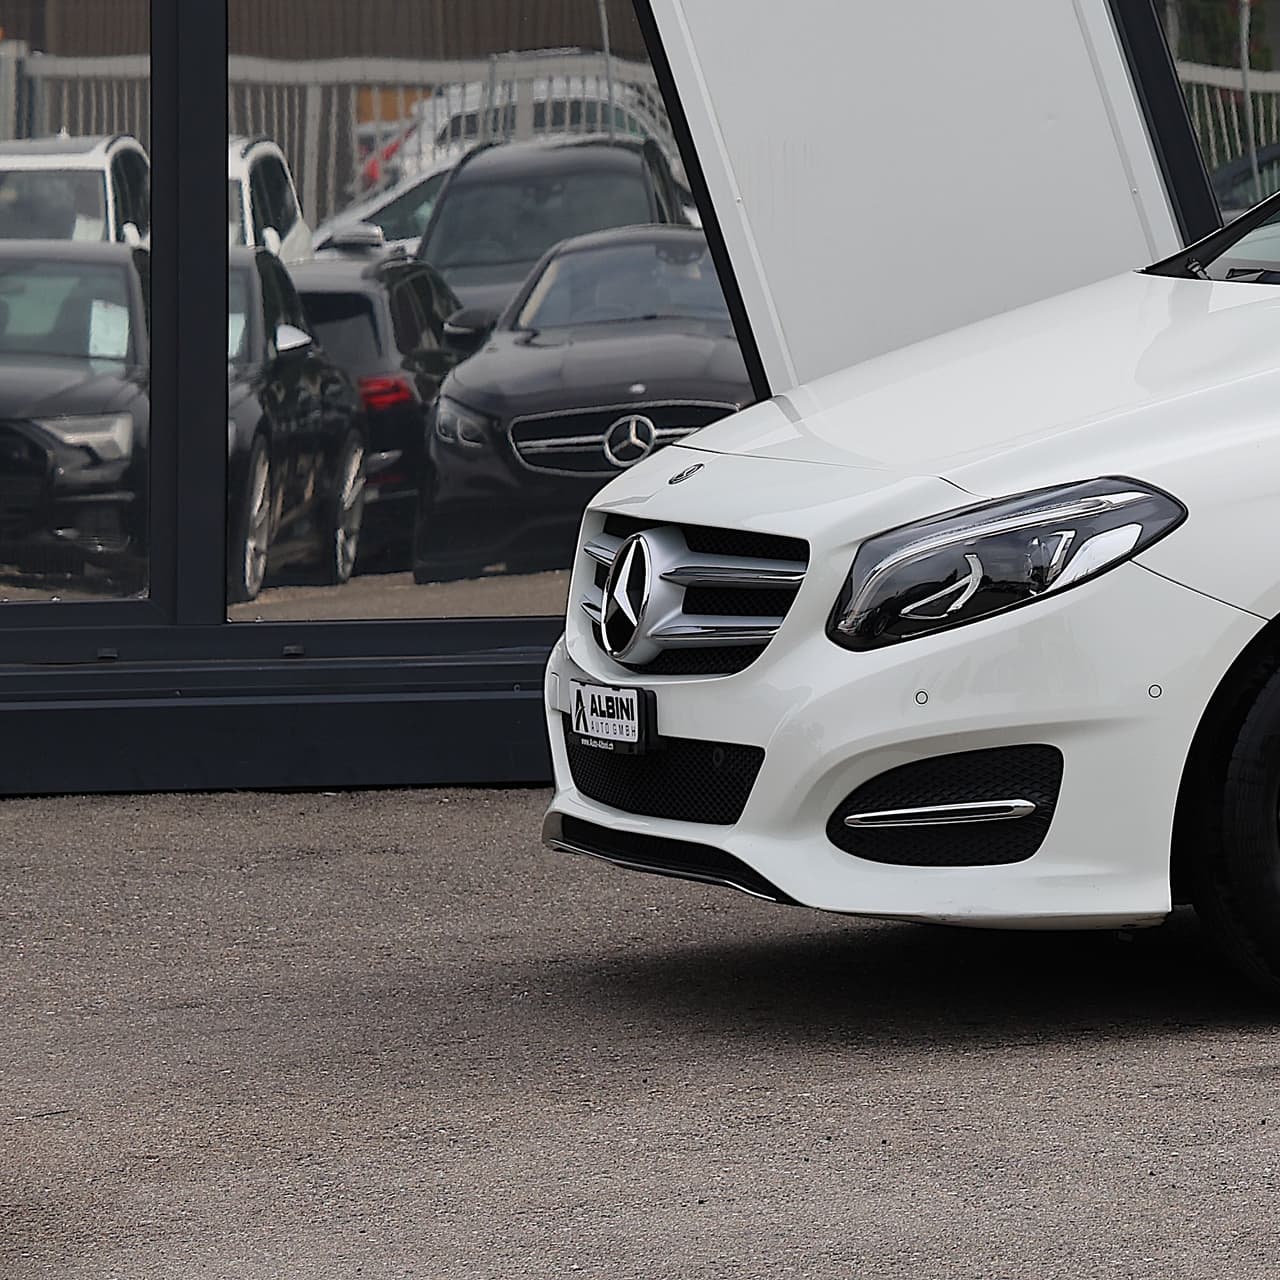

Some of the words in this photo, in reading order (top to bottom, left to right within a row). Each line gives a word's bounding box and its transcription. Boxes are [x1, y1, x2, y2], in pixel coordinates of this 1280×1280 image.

[590, 694, 635, 721] ALBINI
[591, 720, 610, 735] AUTO
[612, 723, 637, 738] GMBH
